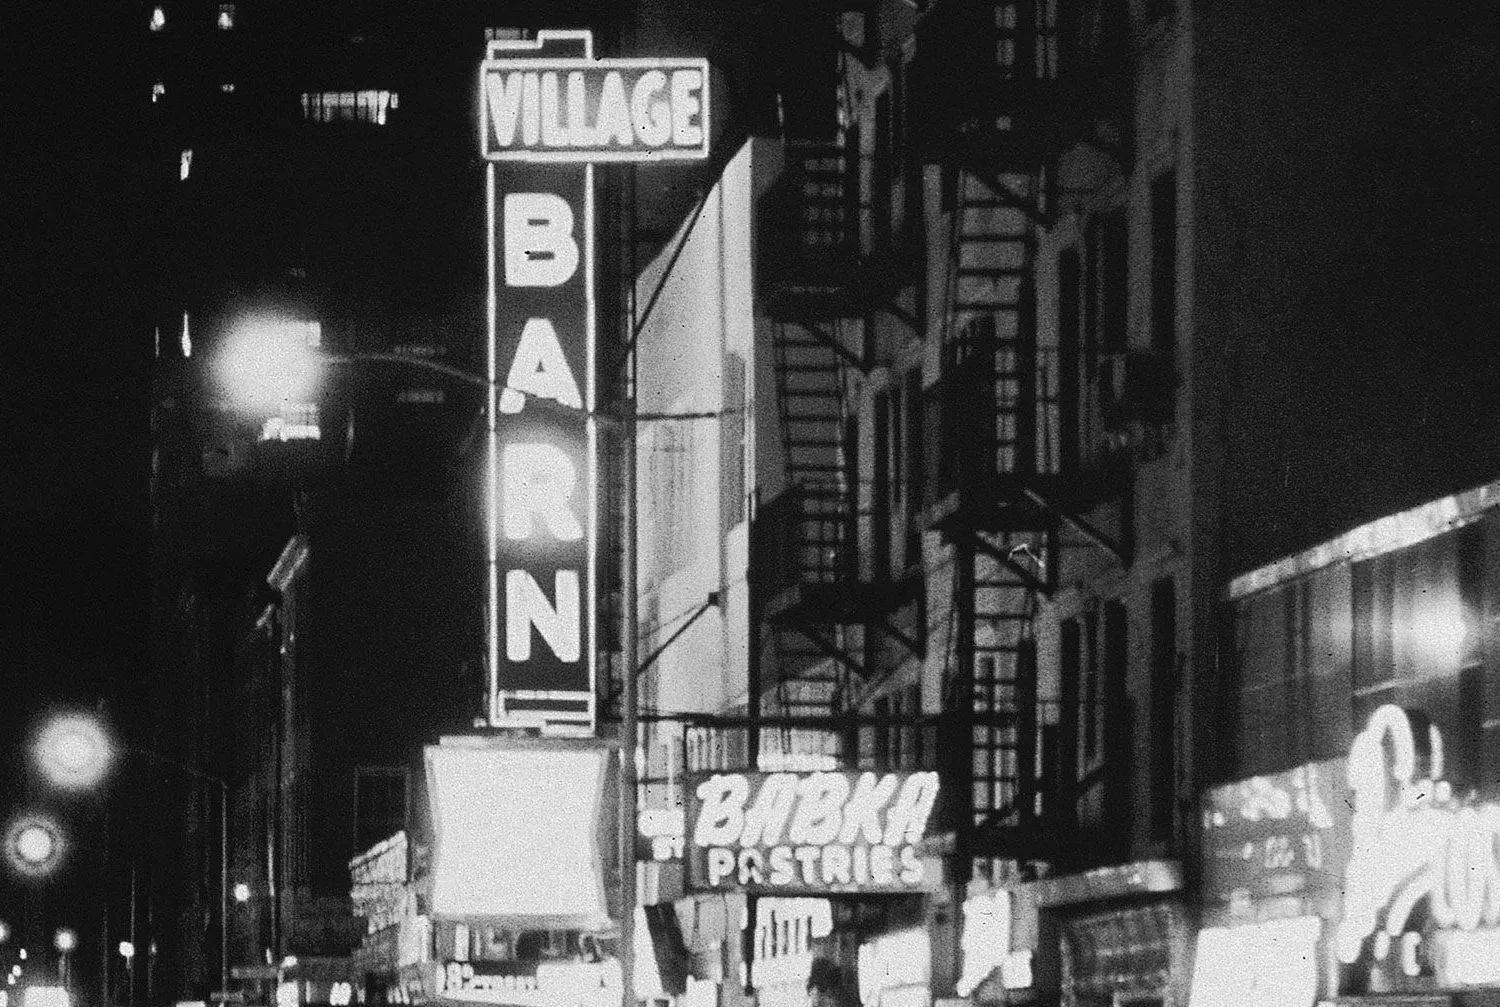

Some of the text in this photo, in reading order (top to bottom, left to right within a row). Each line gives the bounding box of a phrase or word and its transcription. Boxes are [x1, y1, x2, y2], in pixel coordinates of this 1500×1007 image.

[486, 70, 702, 148] VILLAGE
[501, 191, 585, 664] BARN
[694, 770, 940, 847] BABKA
[707, 844, 925, 887] PASTRIES
